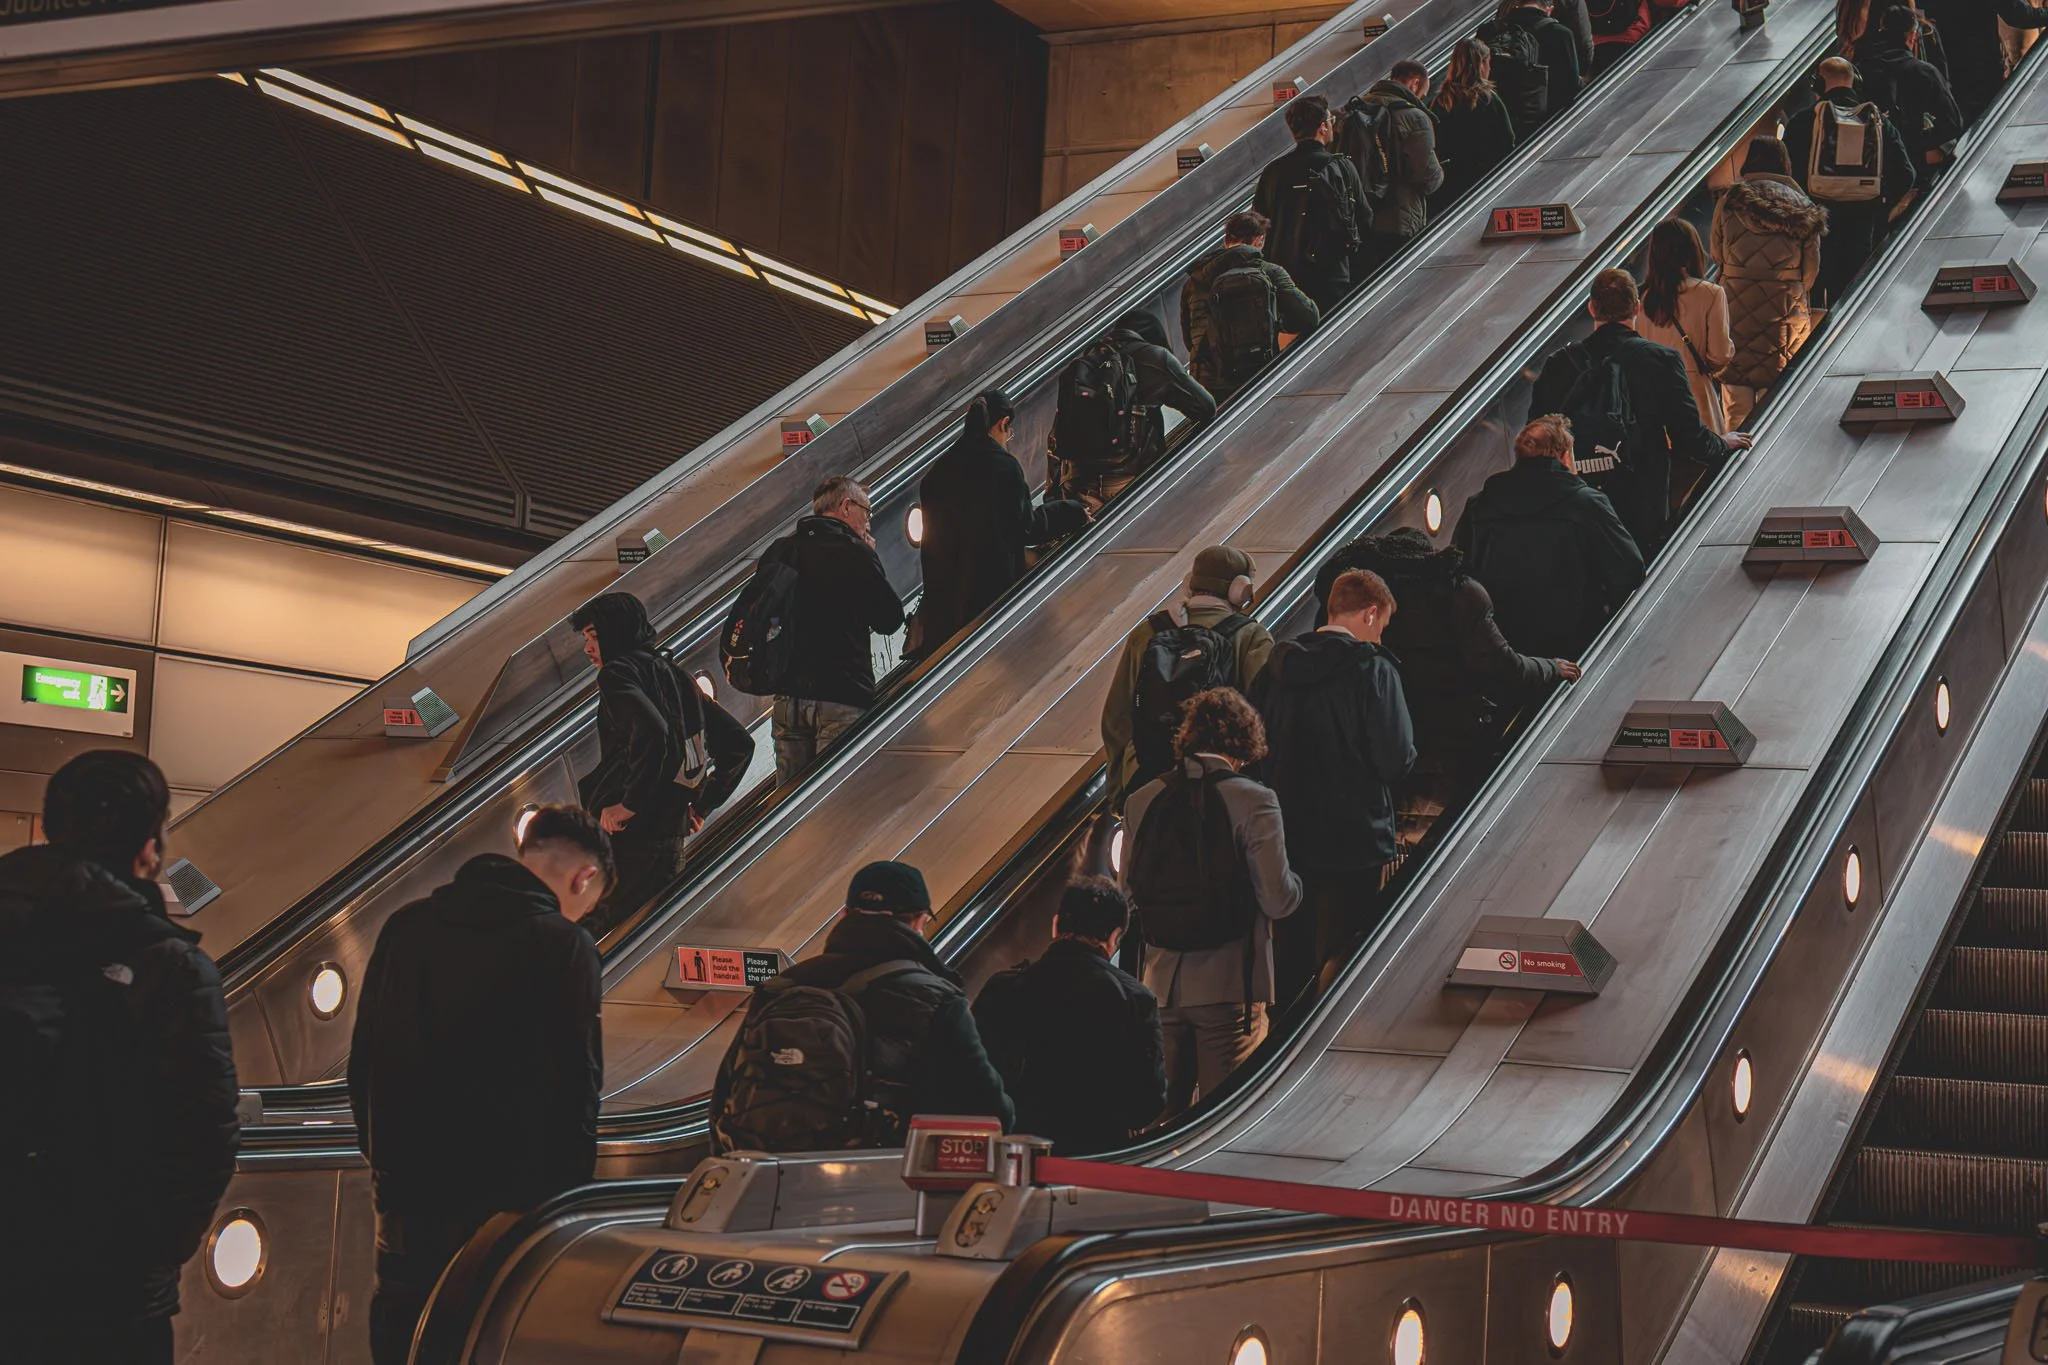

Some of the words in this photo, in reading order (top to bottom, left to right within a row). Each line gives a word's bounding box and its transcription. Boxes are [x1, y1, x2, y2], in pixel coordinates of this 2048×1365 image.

[711, 955, 733, 964] Please
[746, 956, 769, 966] Please
[1536, 960, 1567, 970] smoking
[747, 966, 766, 974] stand
[767, 967, 777, 975] on
[713, 972, 740, 981] handrail
[748, 974, 760, 982] the
[941, 1138, 985, 1154] STOP
[1389, 1196, 1489, 1226] DANGER
[1501, 1205, 1535, 1229] NO
[1547, 1208, 1630, 1235] ENTRY
